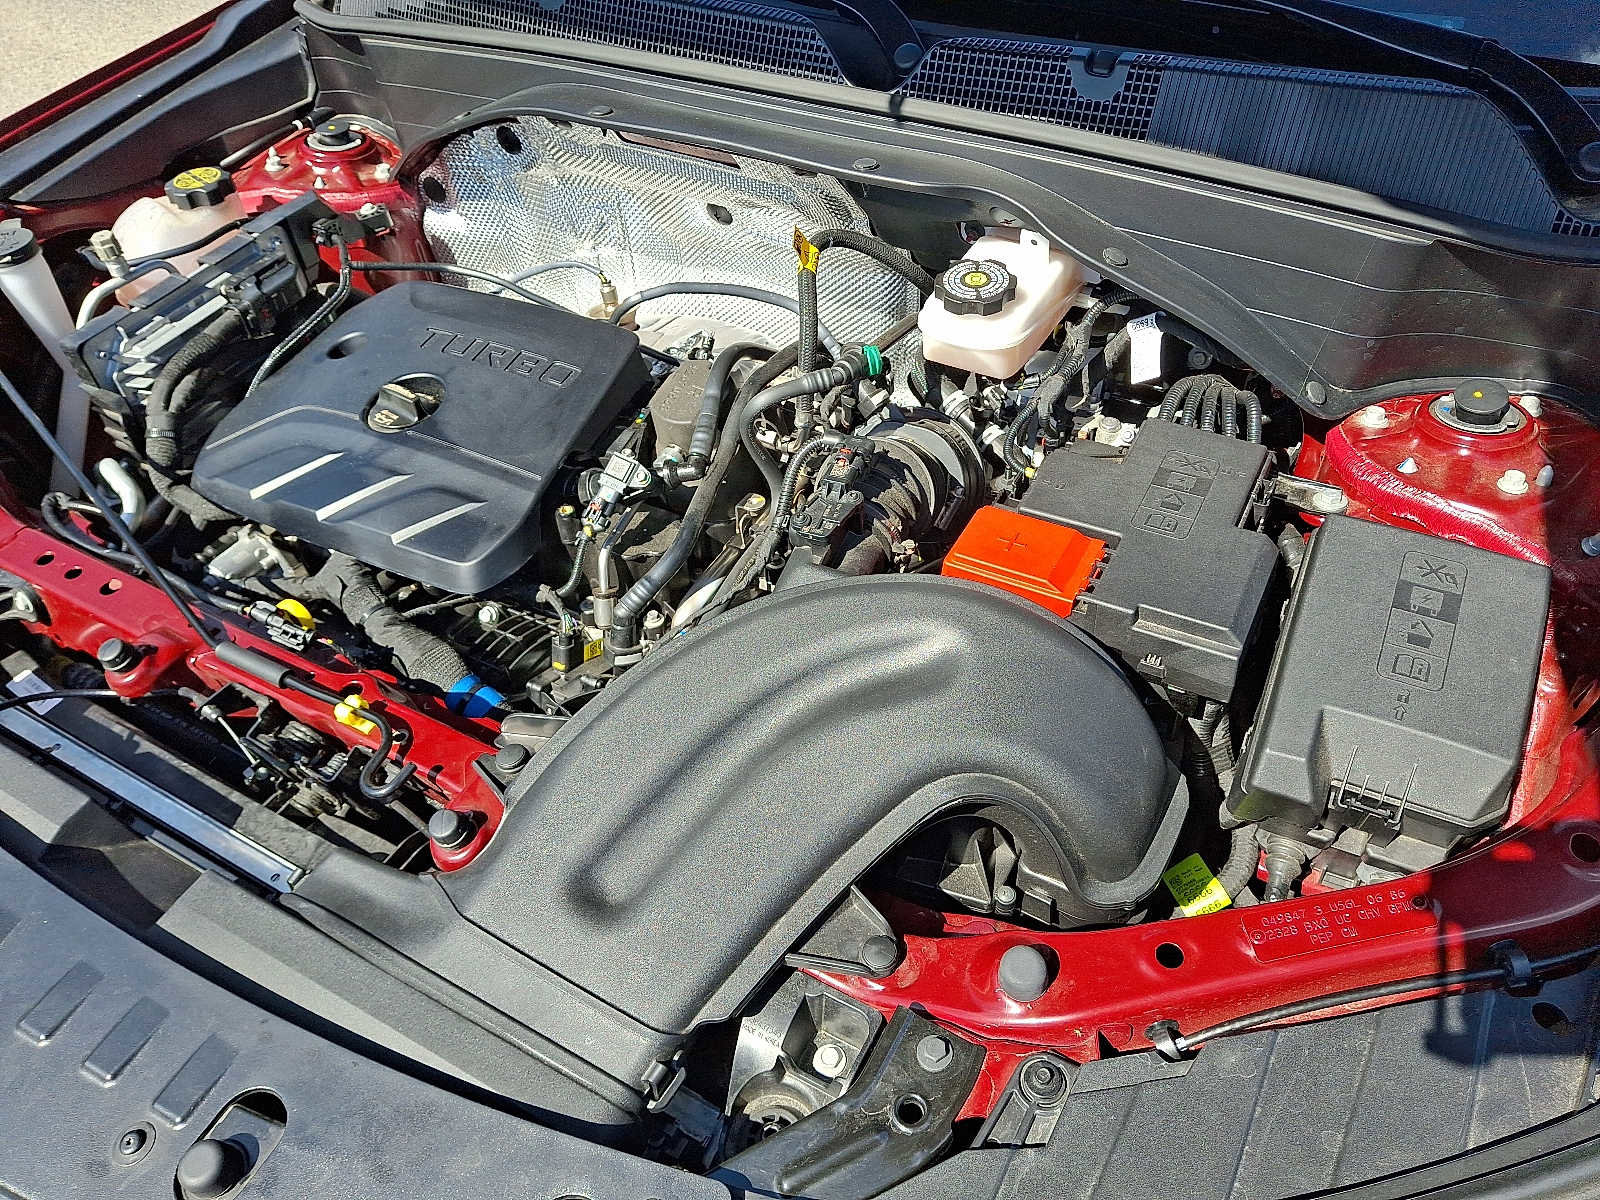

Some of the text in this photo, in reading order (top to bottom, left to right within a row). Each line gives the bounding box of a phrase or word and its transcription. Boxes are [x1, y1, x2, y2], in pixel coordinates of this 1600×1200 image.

[420, 327, 583, 388] TURBO
[1313, 905, 1324, 916] 3
[1366, 892, 1383, 905] 06
